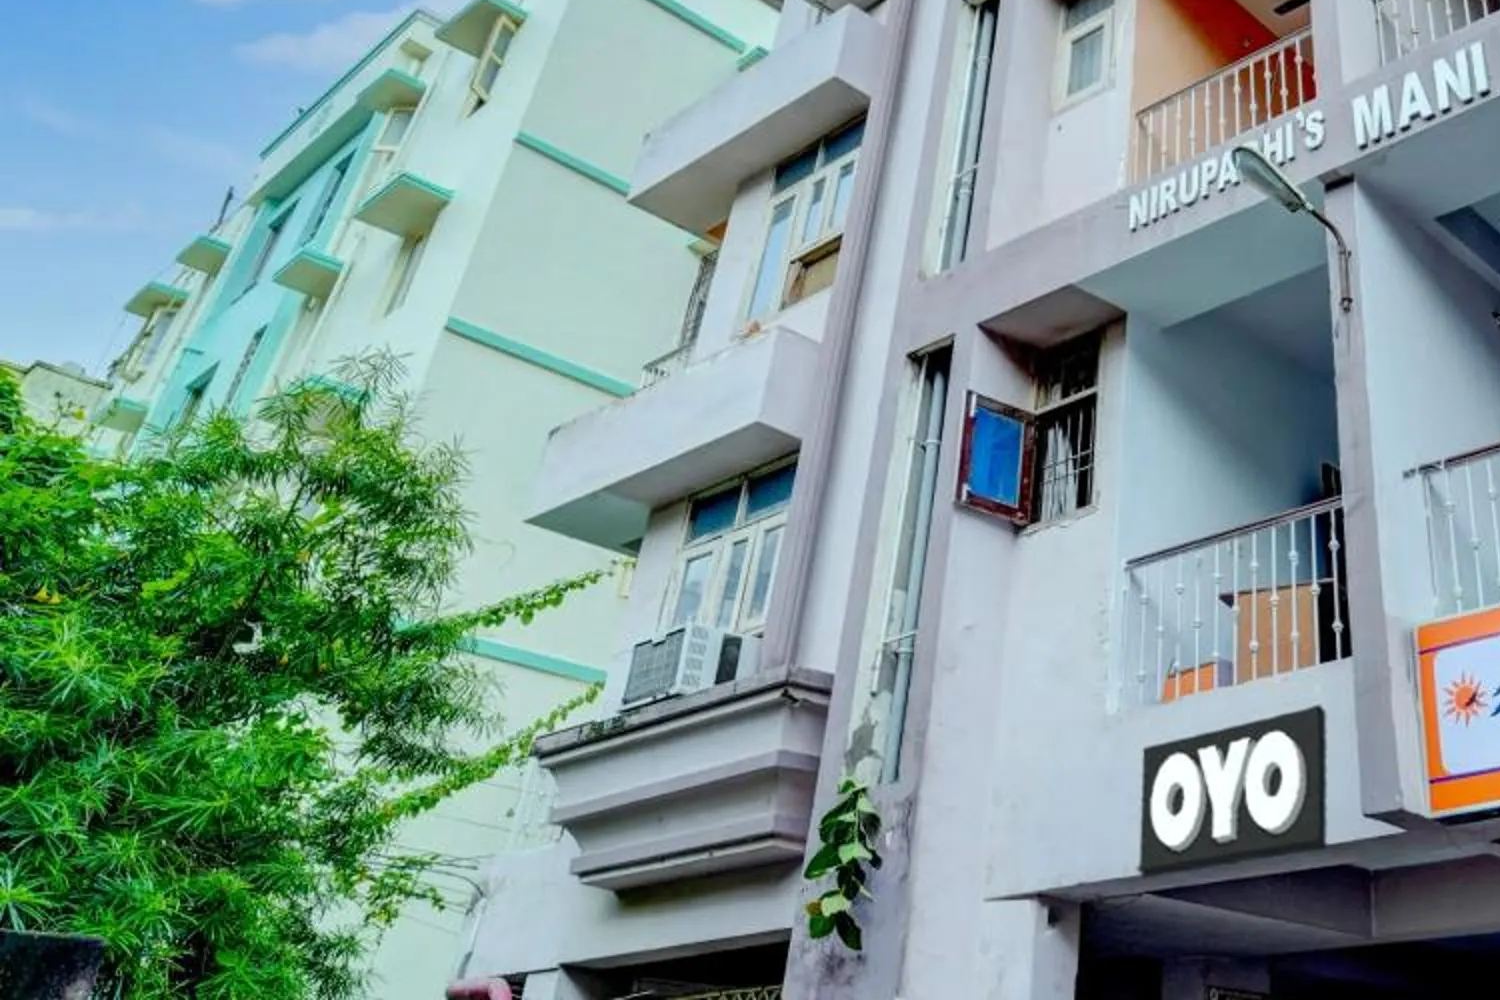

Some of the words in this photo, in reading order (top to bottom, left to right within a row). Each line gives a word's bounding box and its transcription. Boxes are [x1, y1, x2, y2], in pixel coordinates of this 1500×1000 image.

[1128, 110, 1326, 231] NIRUPAHI'S
[1353, 42, 1491, 149] MANI
[1150, 730, 1307, 852] OYO
